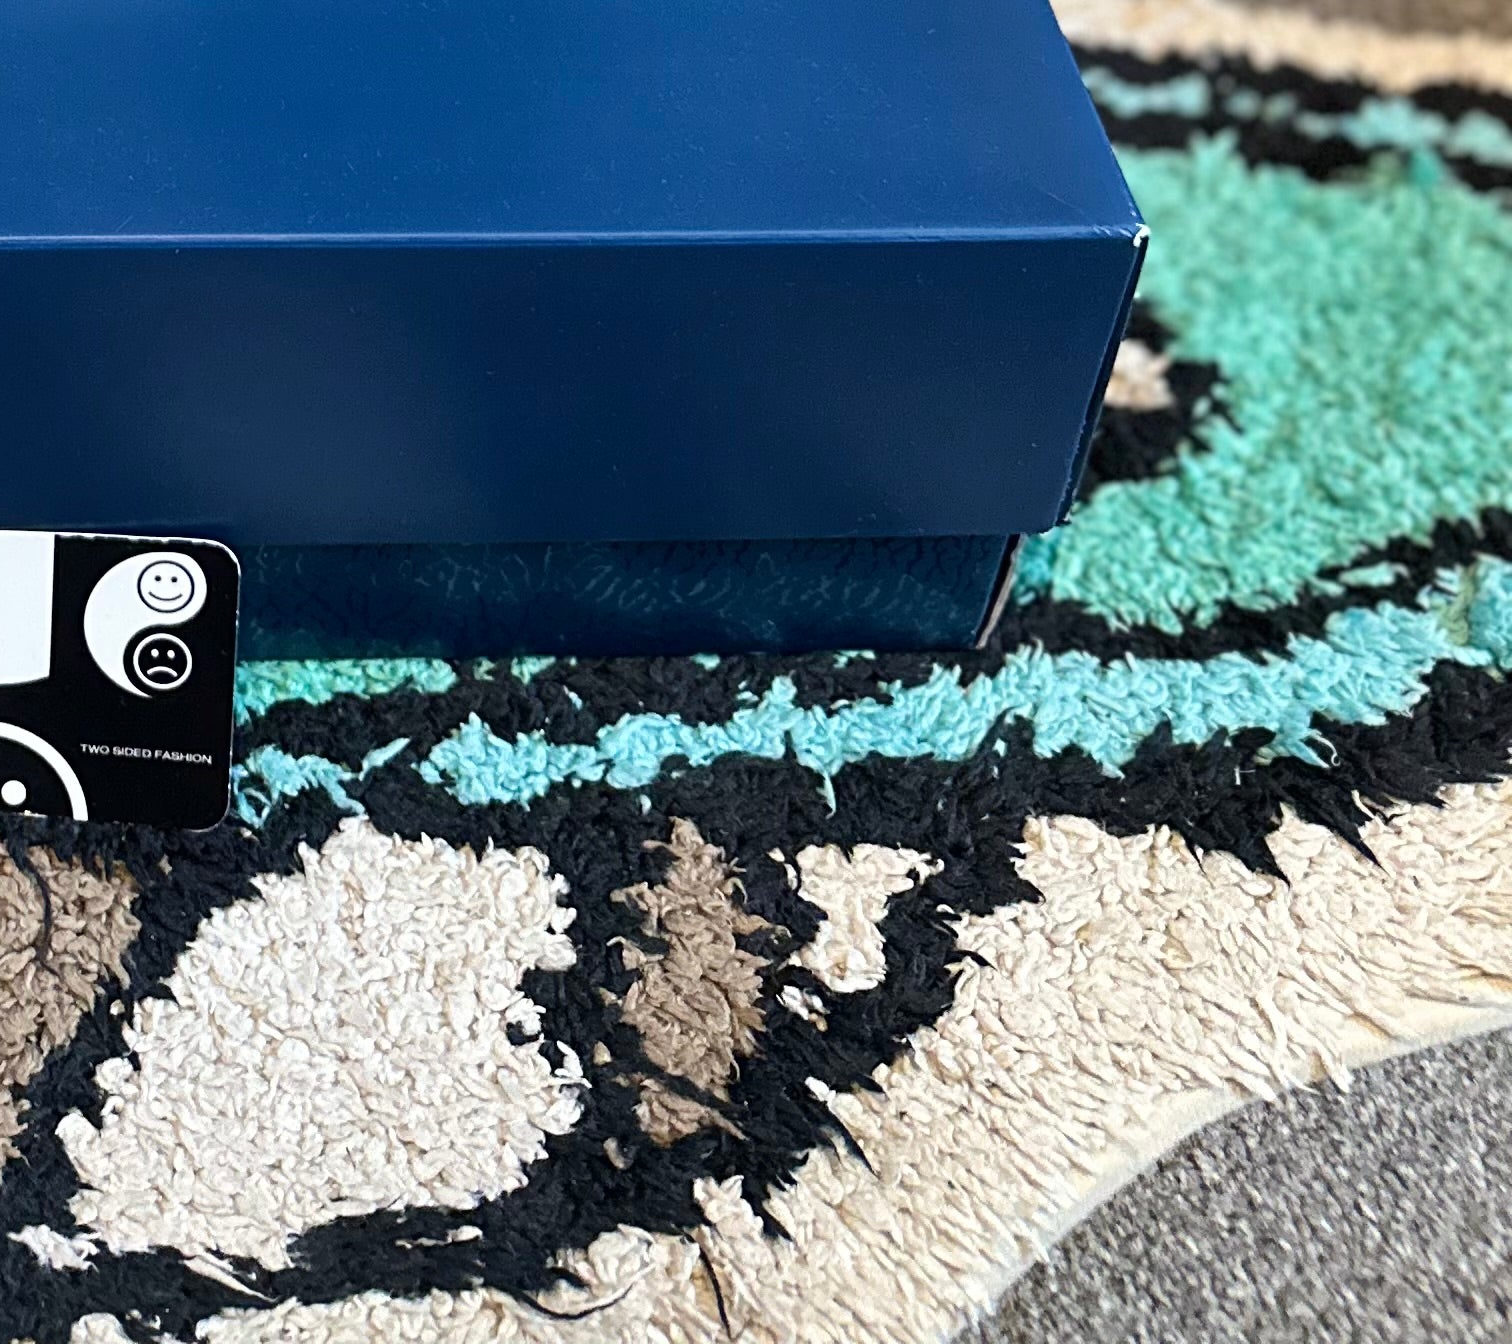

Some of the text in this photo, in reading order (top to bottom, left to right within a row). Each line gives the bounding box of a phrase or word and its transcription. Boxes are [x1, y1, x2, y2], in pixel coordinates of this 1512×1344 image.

[80, 743, 213, 765] TWO SIDED FASHION
